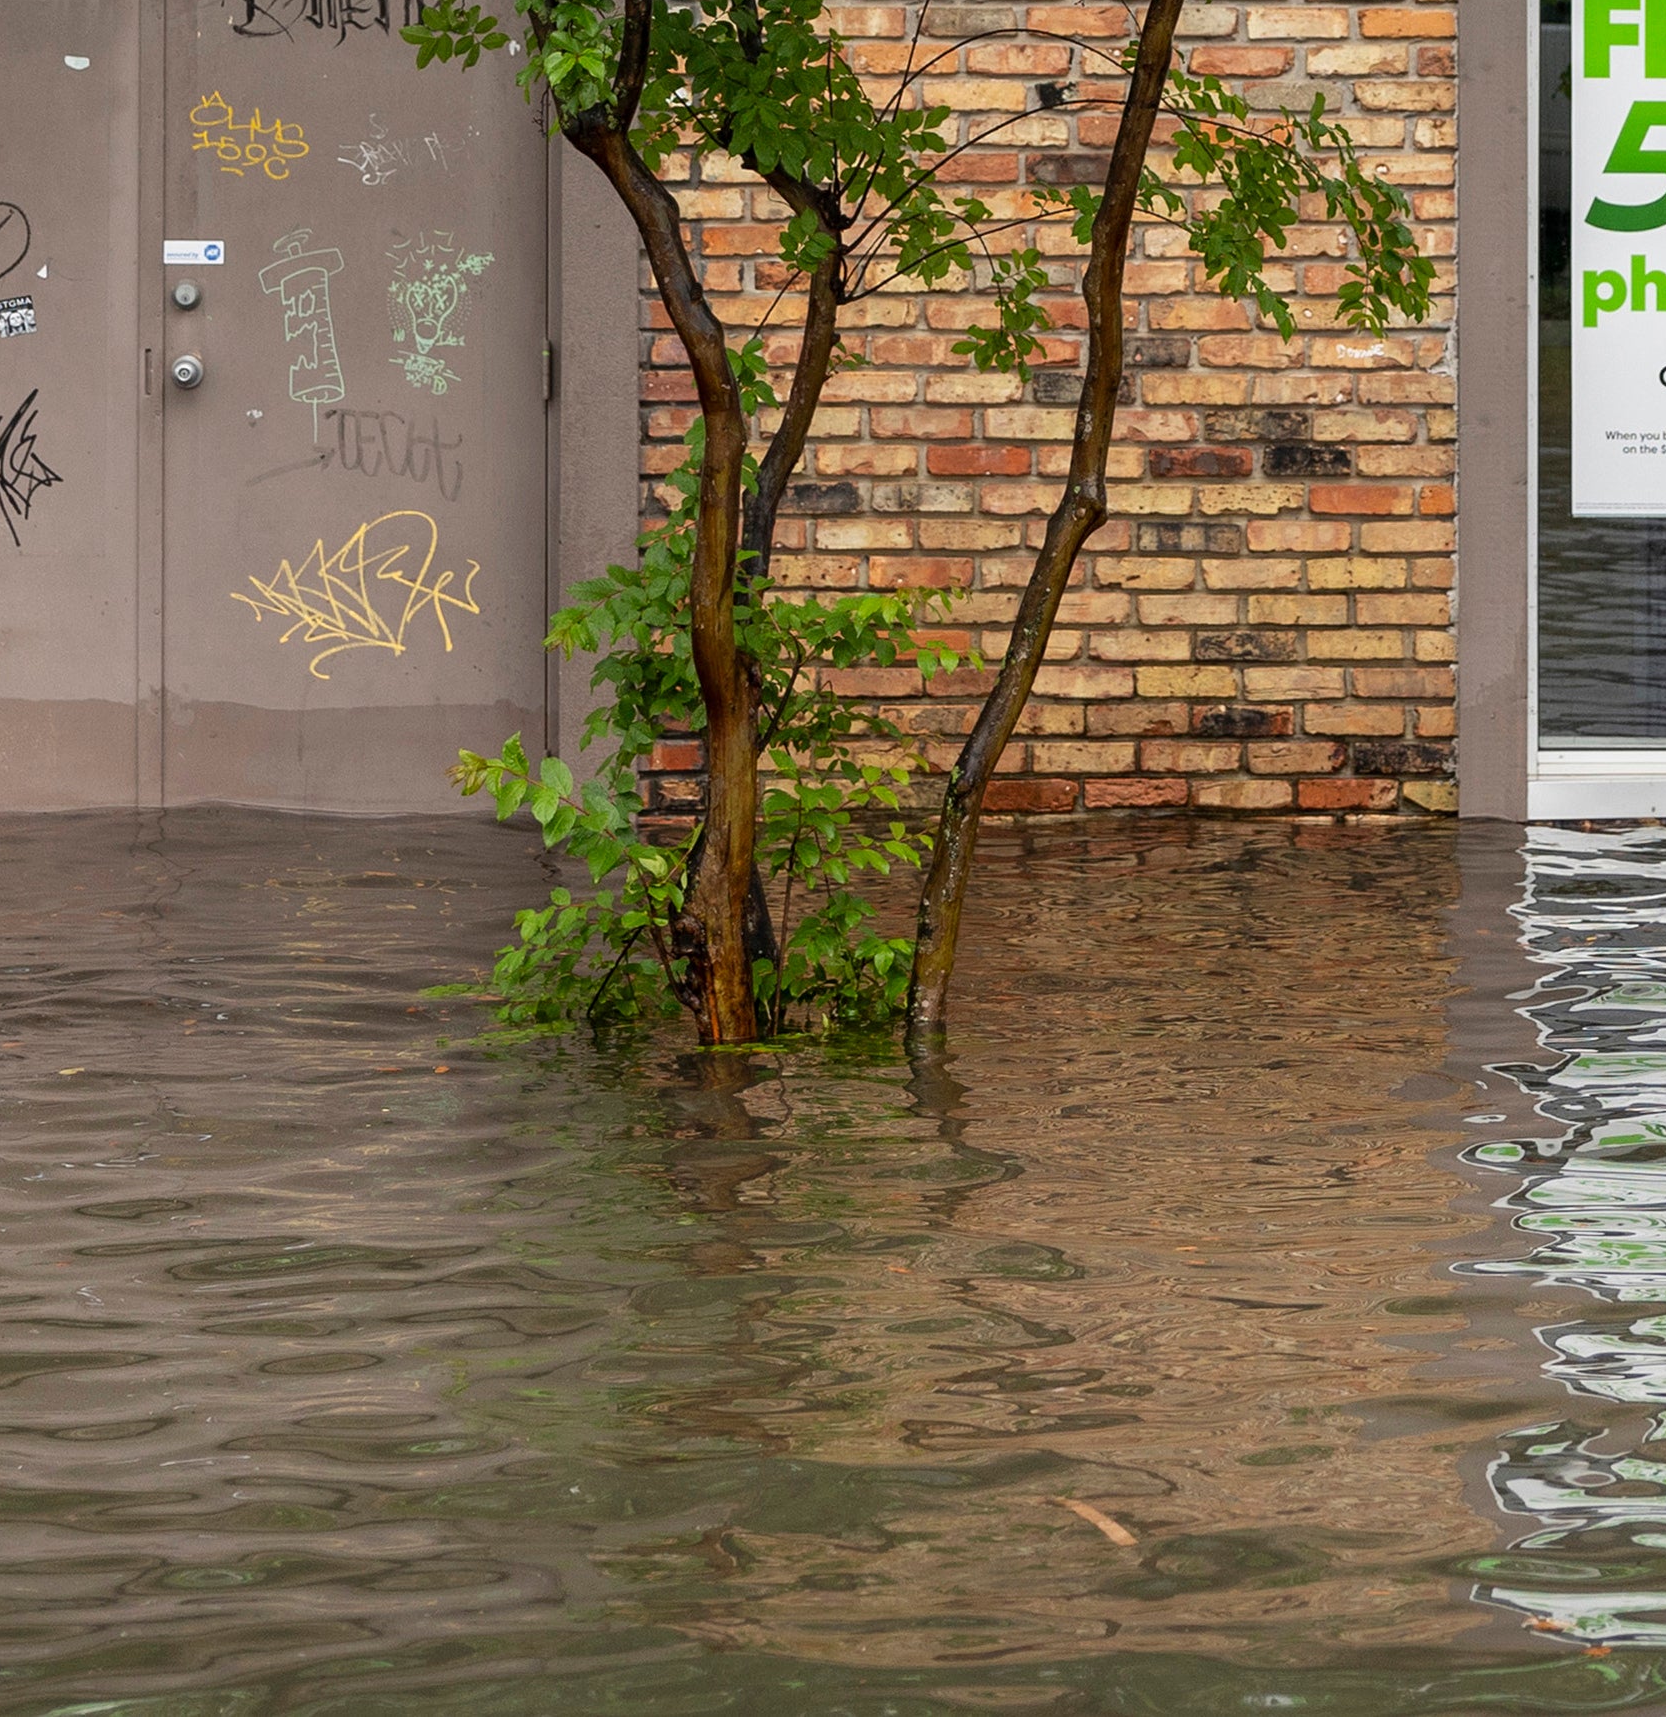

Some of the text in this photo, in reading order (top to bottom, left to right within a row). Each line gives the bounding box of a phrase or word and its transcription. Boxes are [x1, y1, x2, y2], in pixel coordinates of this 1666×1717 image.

[1605, 431, 1637, 441] When
[1640, 433, 1660, 443] you
[1639, 445, 1658, 454] the
